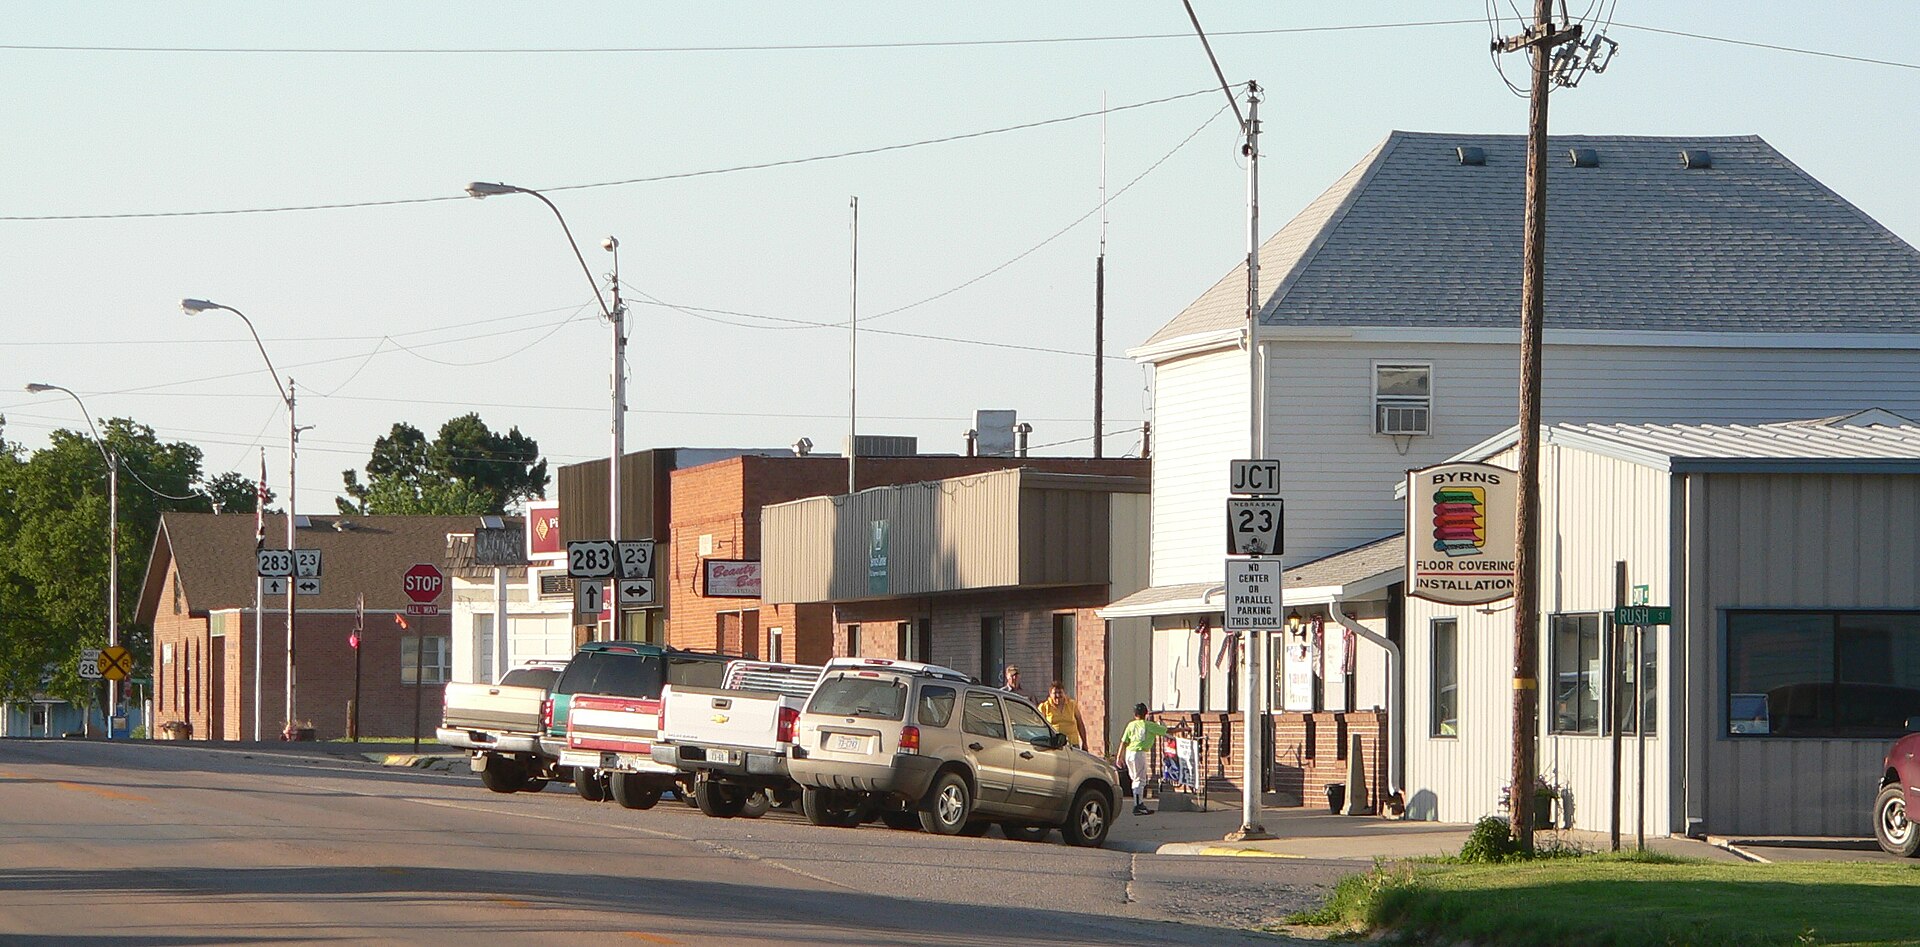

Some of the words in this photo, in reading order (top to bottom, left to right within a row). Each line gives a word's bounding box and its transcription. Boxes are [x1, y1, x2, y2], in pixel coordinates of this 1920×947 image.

[1234, 465, 1276, 489] JCT
[1432, 472, 1501, 485] BYRNS
[549, 517, 559, 528] Pi
[1238, 509, 1273, 533] 23
[299, 554, 316, 566] 23
[572, 548, 610, 570] 283
[624, 548, 647, 564] 23
[261, 555, 289, 571] 283
[1248, 563, 1259, 572] NO
[1416, 561, 1453, 571] FLOOR
[1458, 561, 1515, 571] COVERING
[713, 564, 757, 578] Beauty
[405, 575, 441, 591] STOP
[1238, 574, 1269, 583] CENTER
[1416, 578, 1515, 590] INSTALLATION
[1248, 585, 1259, 593] OR
[1234, 595, 1273, 604] PARALLEL
[407, 605, 420, 614] ALL
[423, 605, 438, 614] WAY
[1237, 606, 1272, 615] PARKING
[1231, 617, 1250, 626] THIS
[1252, 617, 1278, 626] BLOCK
[1620, 608, 1649, 624] RUSH
[100, 658, 107, 668] R
[122, 658, 129, 668] R
